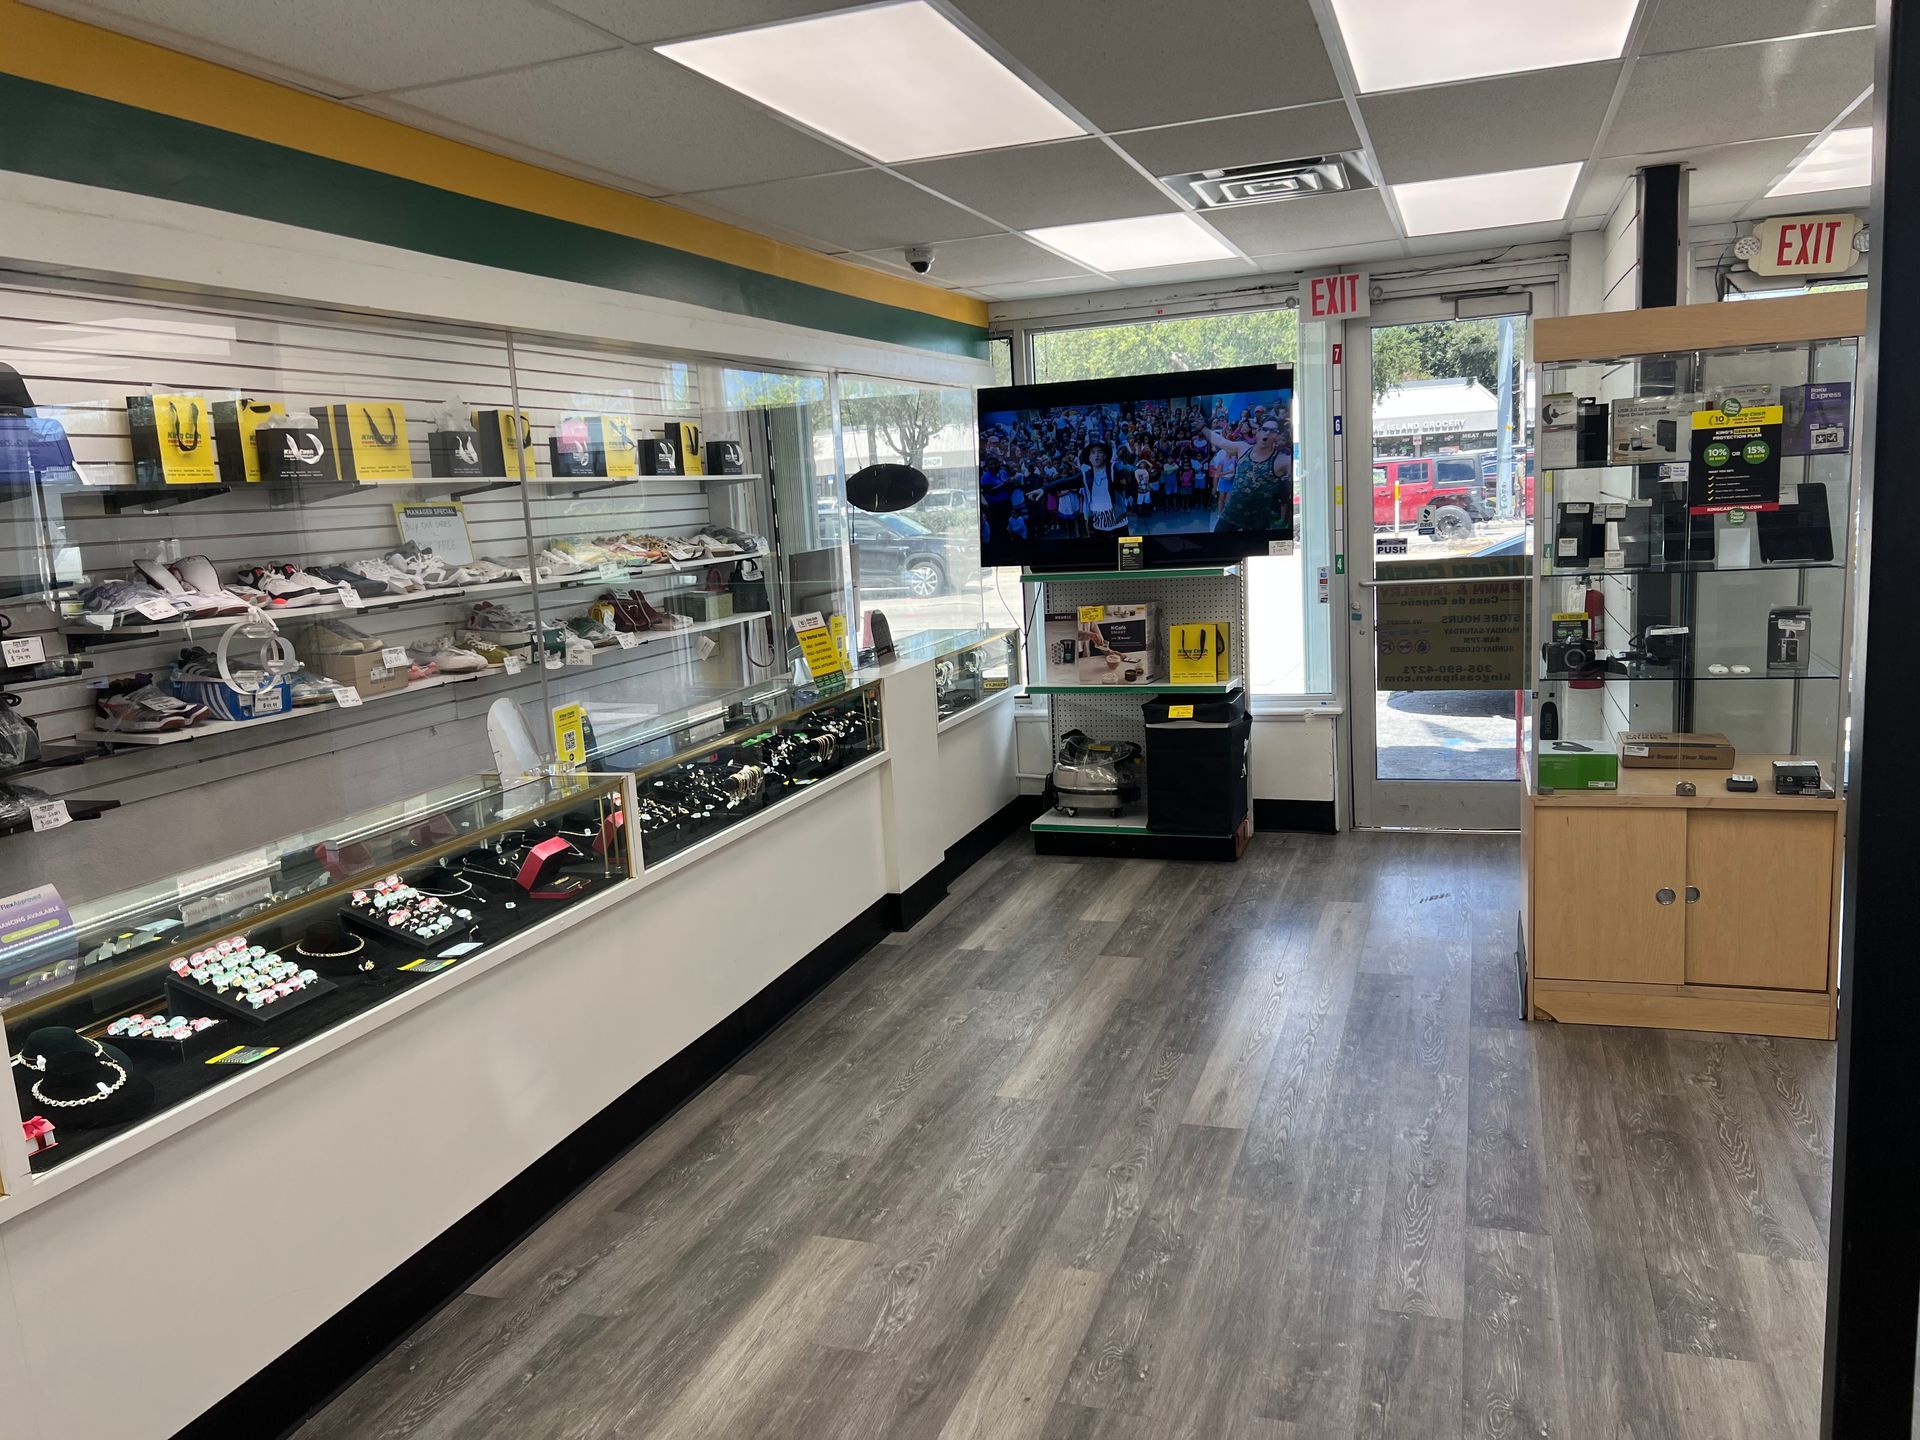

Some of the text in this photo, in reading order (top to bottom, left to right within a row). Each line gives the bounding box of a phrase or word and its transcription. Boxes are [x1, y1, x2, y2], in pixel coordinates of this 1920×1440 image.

[1777, 222, 1841, 266] EXIT
[1311, 274, 1359, 317] EXIT
[1334, 348, 1340, 361] 7
[1811, 392, 1841, 400] Express
[1335, 419, 1341, 431] 6
[1387, 422, 1420, 431] ISLAND
[1423, 418, 1466, 428] GROCERY
[1715, 415, 1725, 423] 10
[1708, 448, 1727, 457] 10%
[1747, 445, 1766, 454] 15%
[1377, 546, 1407, 554] PUSH
[1337, 558, 1342, 570] 4
[26, 905, 61, 921] AVAILABLE
